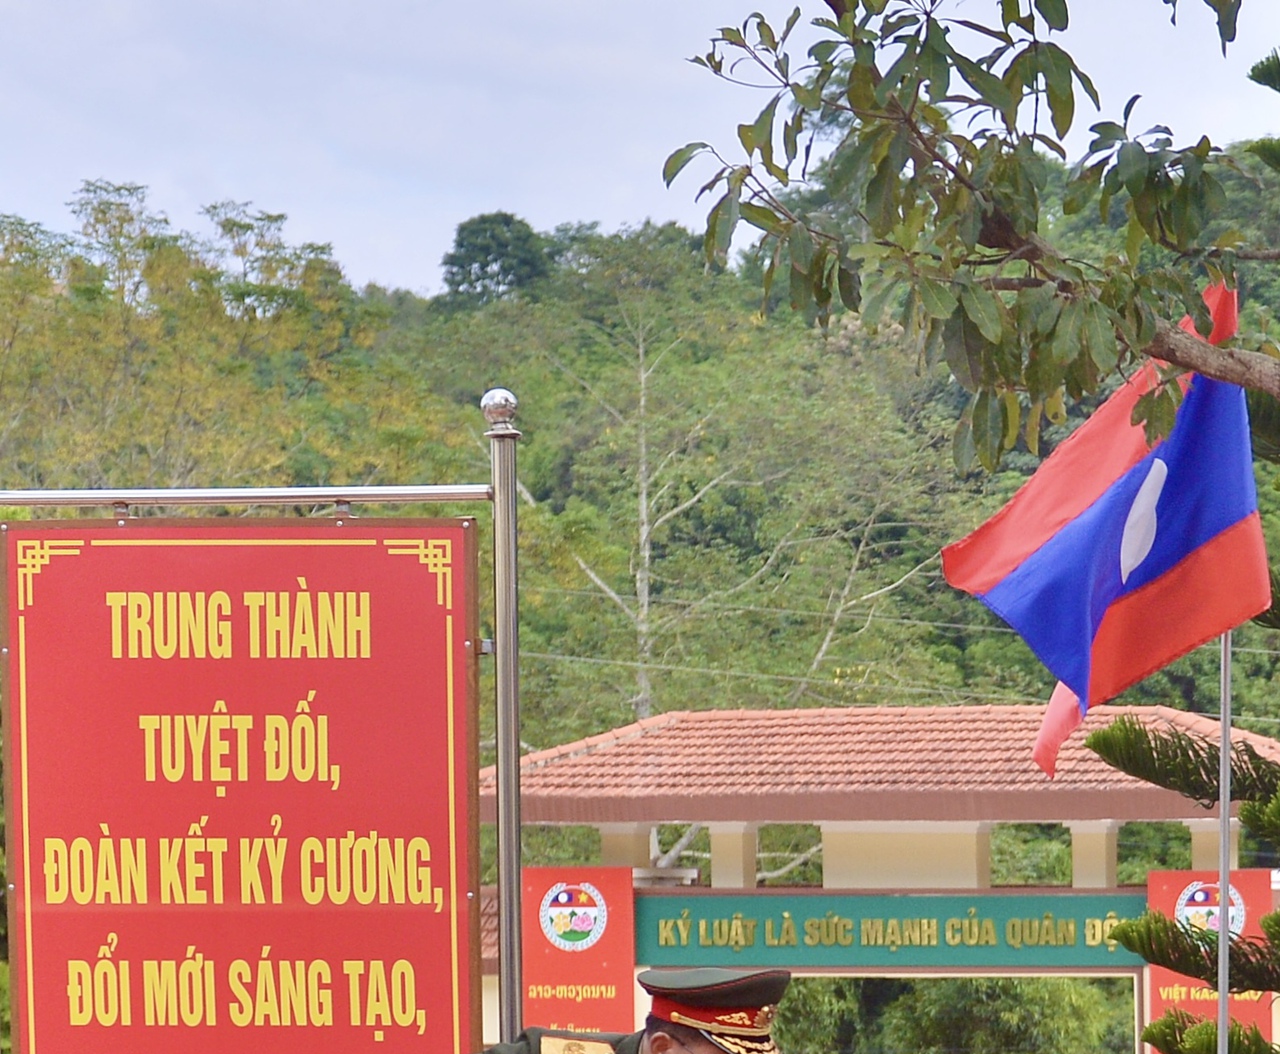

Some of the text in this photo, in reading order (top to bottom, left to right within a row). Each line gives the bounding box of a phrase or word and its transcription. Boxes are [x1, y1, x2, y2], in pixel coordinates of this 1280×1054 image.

[106, 577, 371, 659] TRUNG THÀNH
[139, 690, 341, 796] TUYỆT ĐỐI,
[44, 813, 444, 912] ĐOÀN KẾT KỶ CƯƠNG,
[658, 907, 1126, 952] KỶ LUẬT LÀ SỨC MẠNH CỦA QUÂN ĐỘ
[67, 933, 426, 1041] ĐỔI MỚI SÁNG TẠO,
[1159, 983, 1187, 1004] VIỆT
